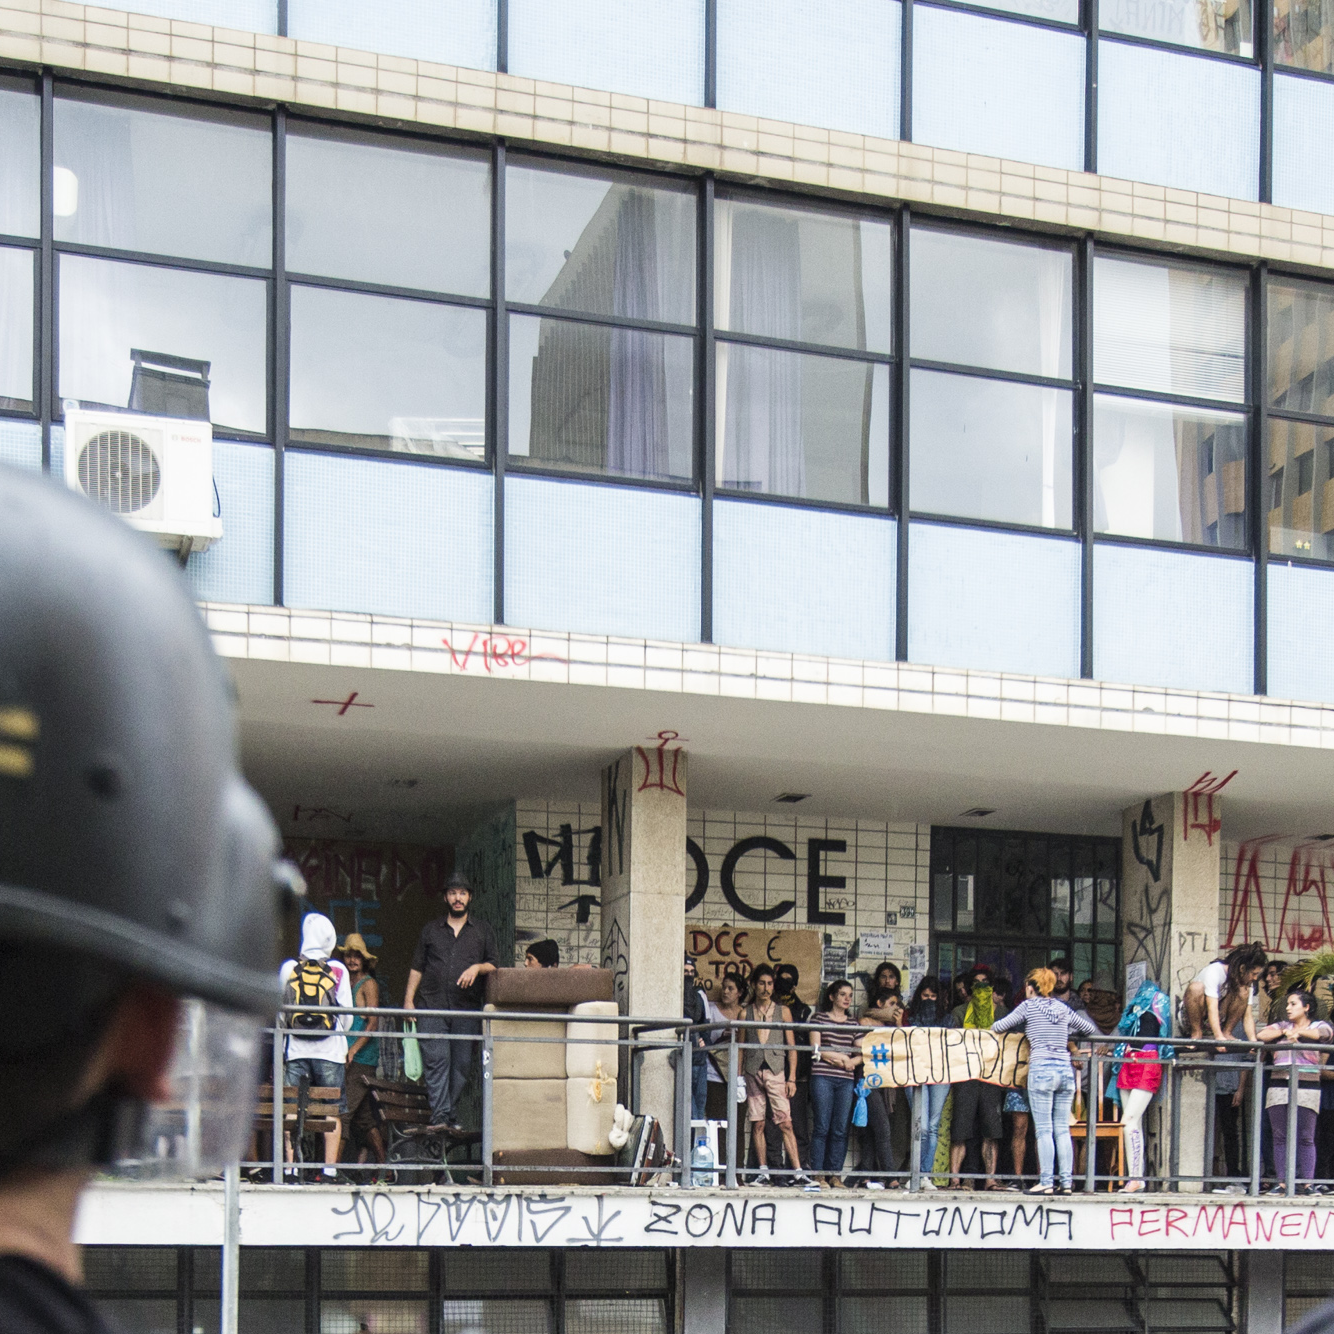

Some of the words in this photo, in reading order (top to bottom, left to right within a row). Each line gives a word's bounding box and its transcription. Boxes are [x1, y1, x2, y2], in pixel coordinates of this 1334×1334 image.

[181, 436, 202, 444] BOSCH
[689, 930, 749, 958] DCE
[644, 1200, 776, 1238] ZONA
